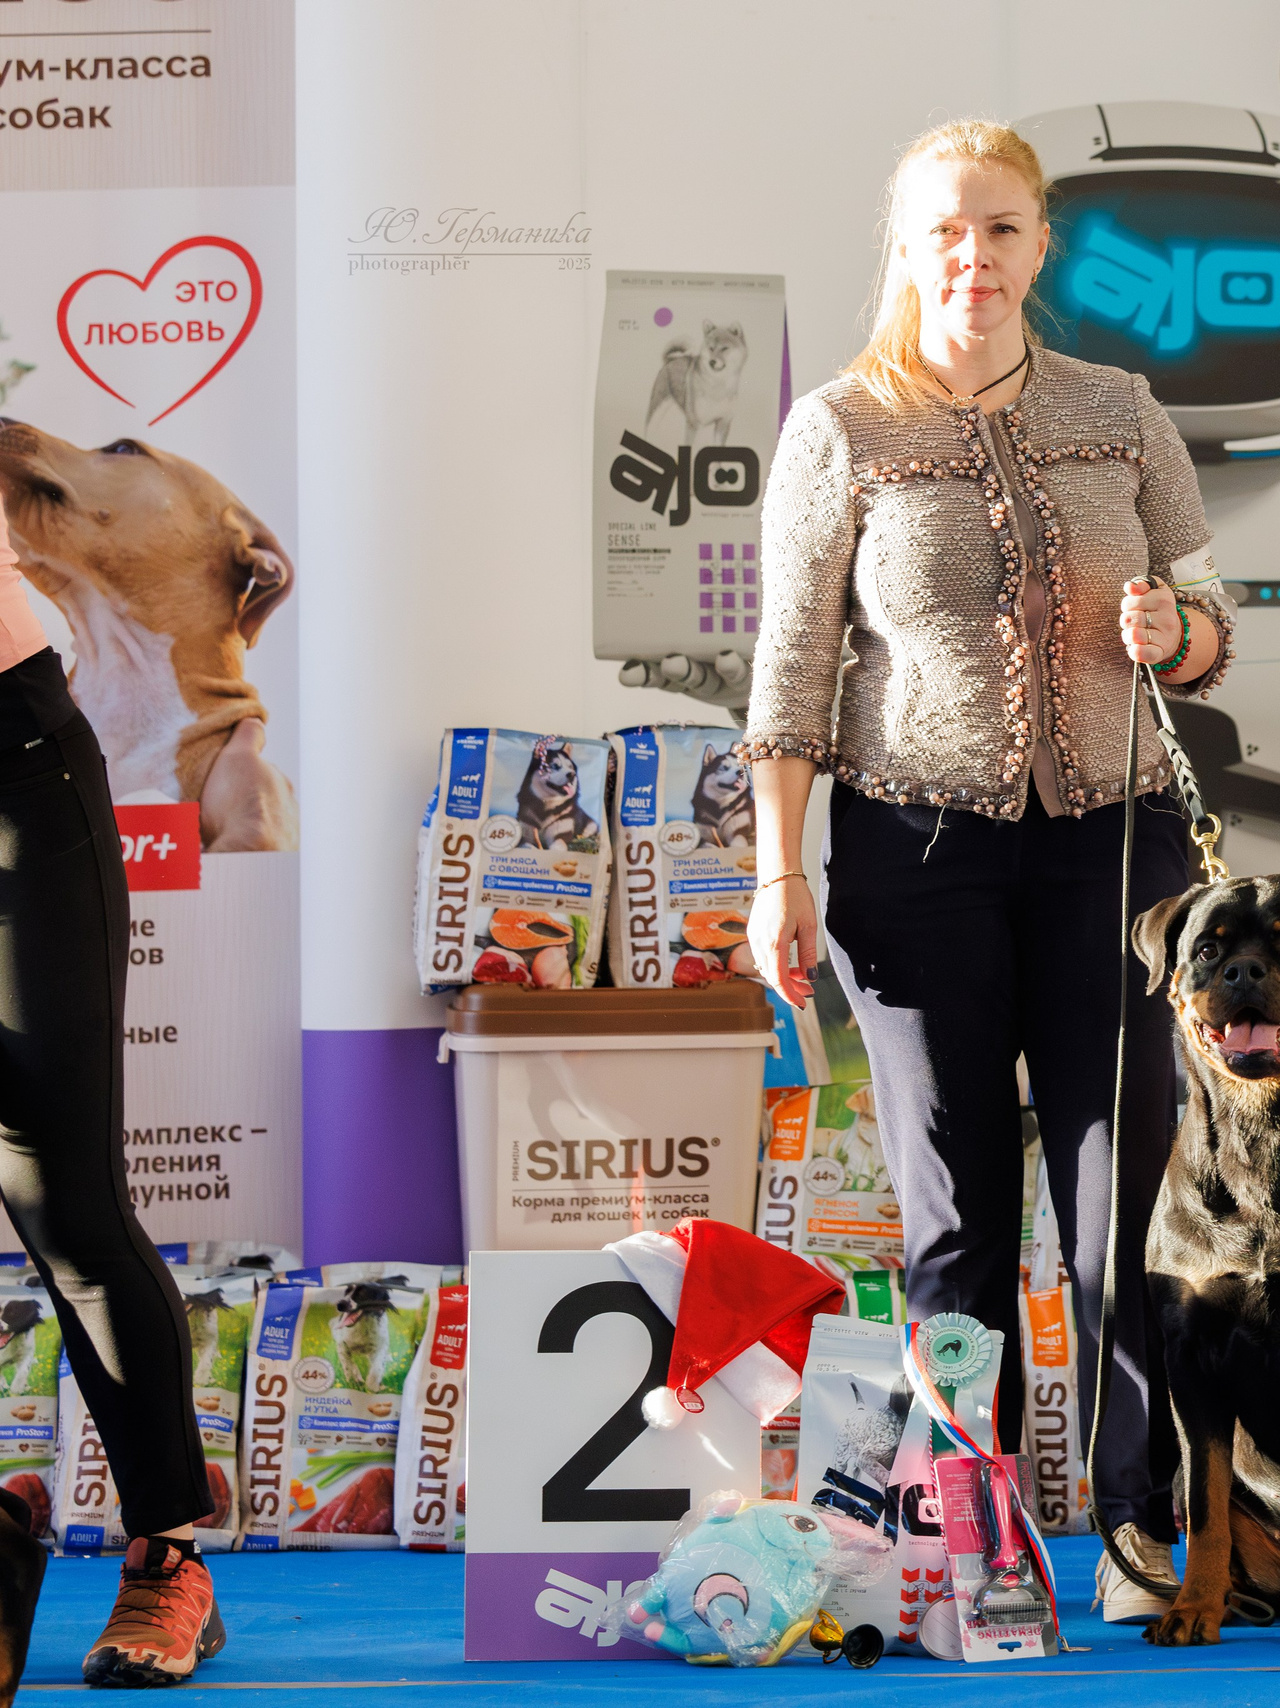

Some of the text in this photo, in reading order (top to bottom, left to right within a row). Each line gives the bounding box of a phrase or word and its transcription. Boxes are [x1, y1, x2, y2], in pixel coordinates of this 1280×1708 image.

[174, 280, 239, 303] ЭТО
[84, 320, 225, 345] ЛЮБОВЬ
[608, 534, 640, 546] SENSE
[451, 785, 478, 798] ADULT
[624, 797, 652, 809] ADULT
[490, 855, 537, 867] ТРИ МЯСА
[673, 858, 720, 867] ТРИ МЯСА
[498, 866, 550, 876] ОВОЩАМИ
[682, 867, 733, 876] ОВОЩАМИ
[432, 833, 475, 974] SIRIUS
[625, 839, 662, 983] SIRIUS
[512, 1136, 711, 1182] PREMIUM SIRIUS
[512, 1192, 710, 1210] Корма премиум-класса
[551, 1206, 710, 1223] для кошек и собак
[264, 1326, 290, 1339] ADULT
[437, 1333, 463, 1348] ADULT
[1036, 1335, 1063, 1346] ADULT
[305, 1396, 353, 1406] ИНДЕЙКА
[537, 1280, 692, 1523] 2
[314, 1406, 338, 1414] УТКА
[250, 1373, 288, 1517] SIRIUS
[413, 1382, 459, 1526] SIRIUS
[1034, 1380, 1068, 1526] SIRIUS
[70, 1533, 98, 1543] ADULT
[977, 1625, 1042, 1640] DEMATTING
